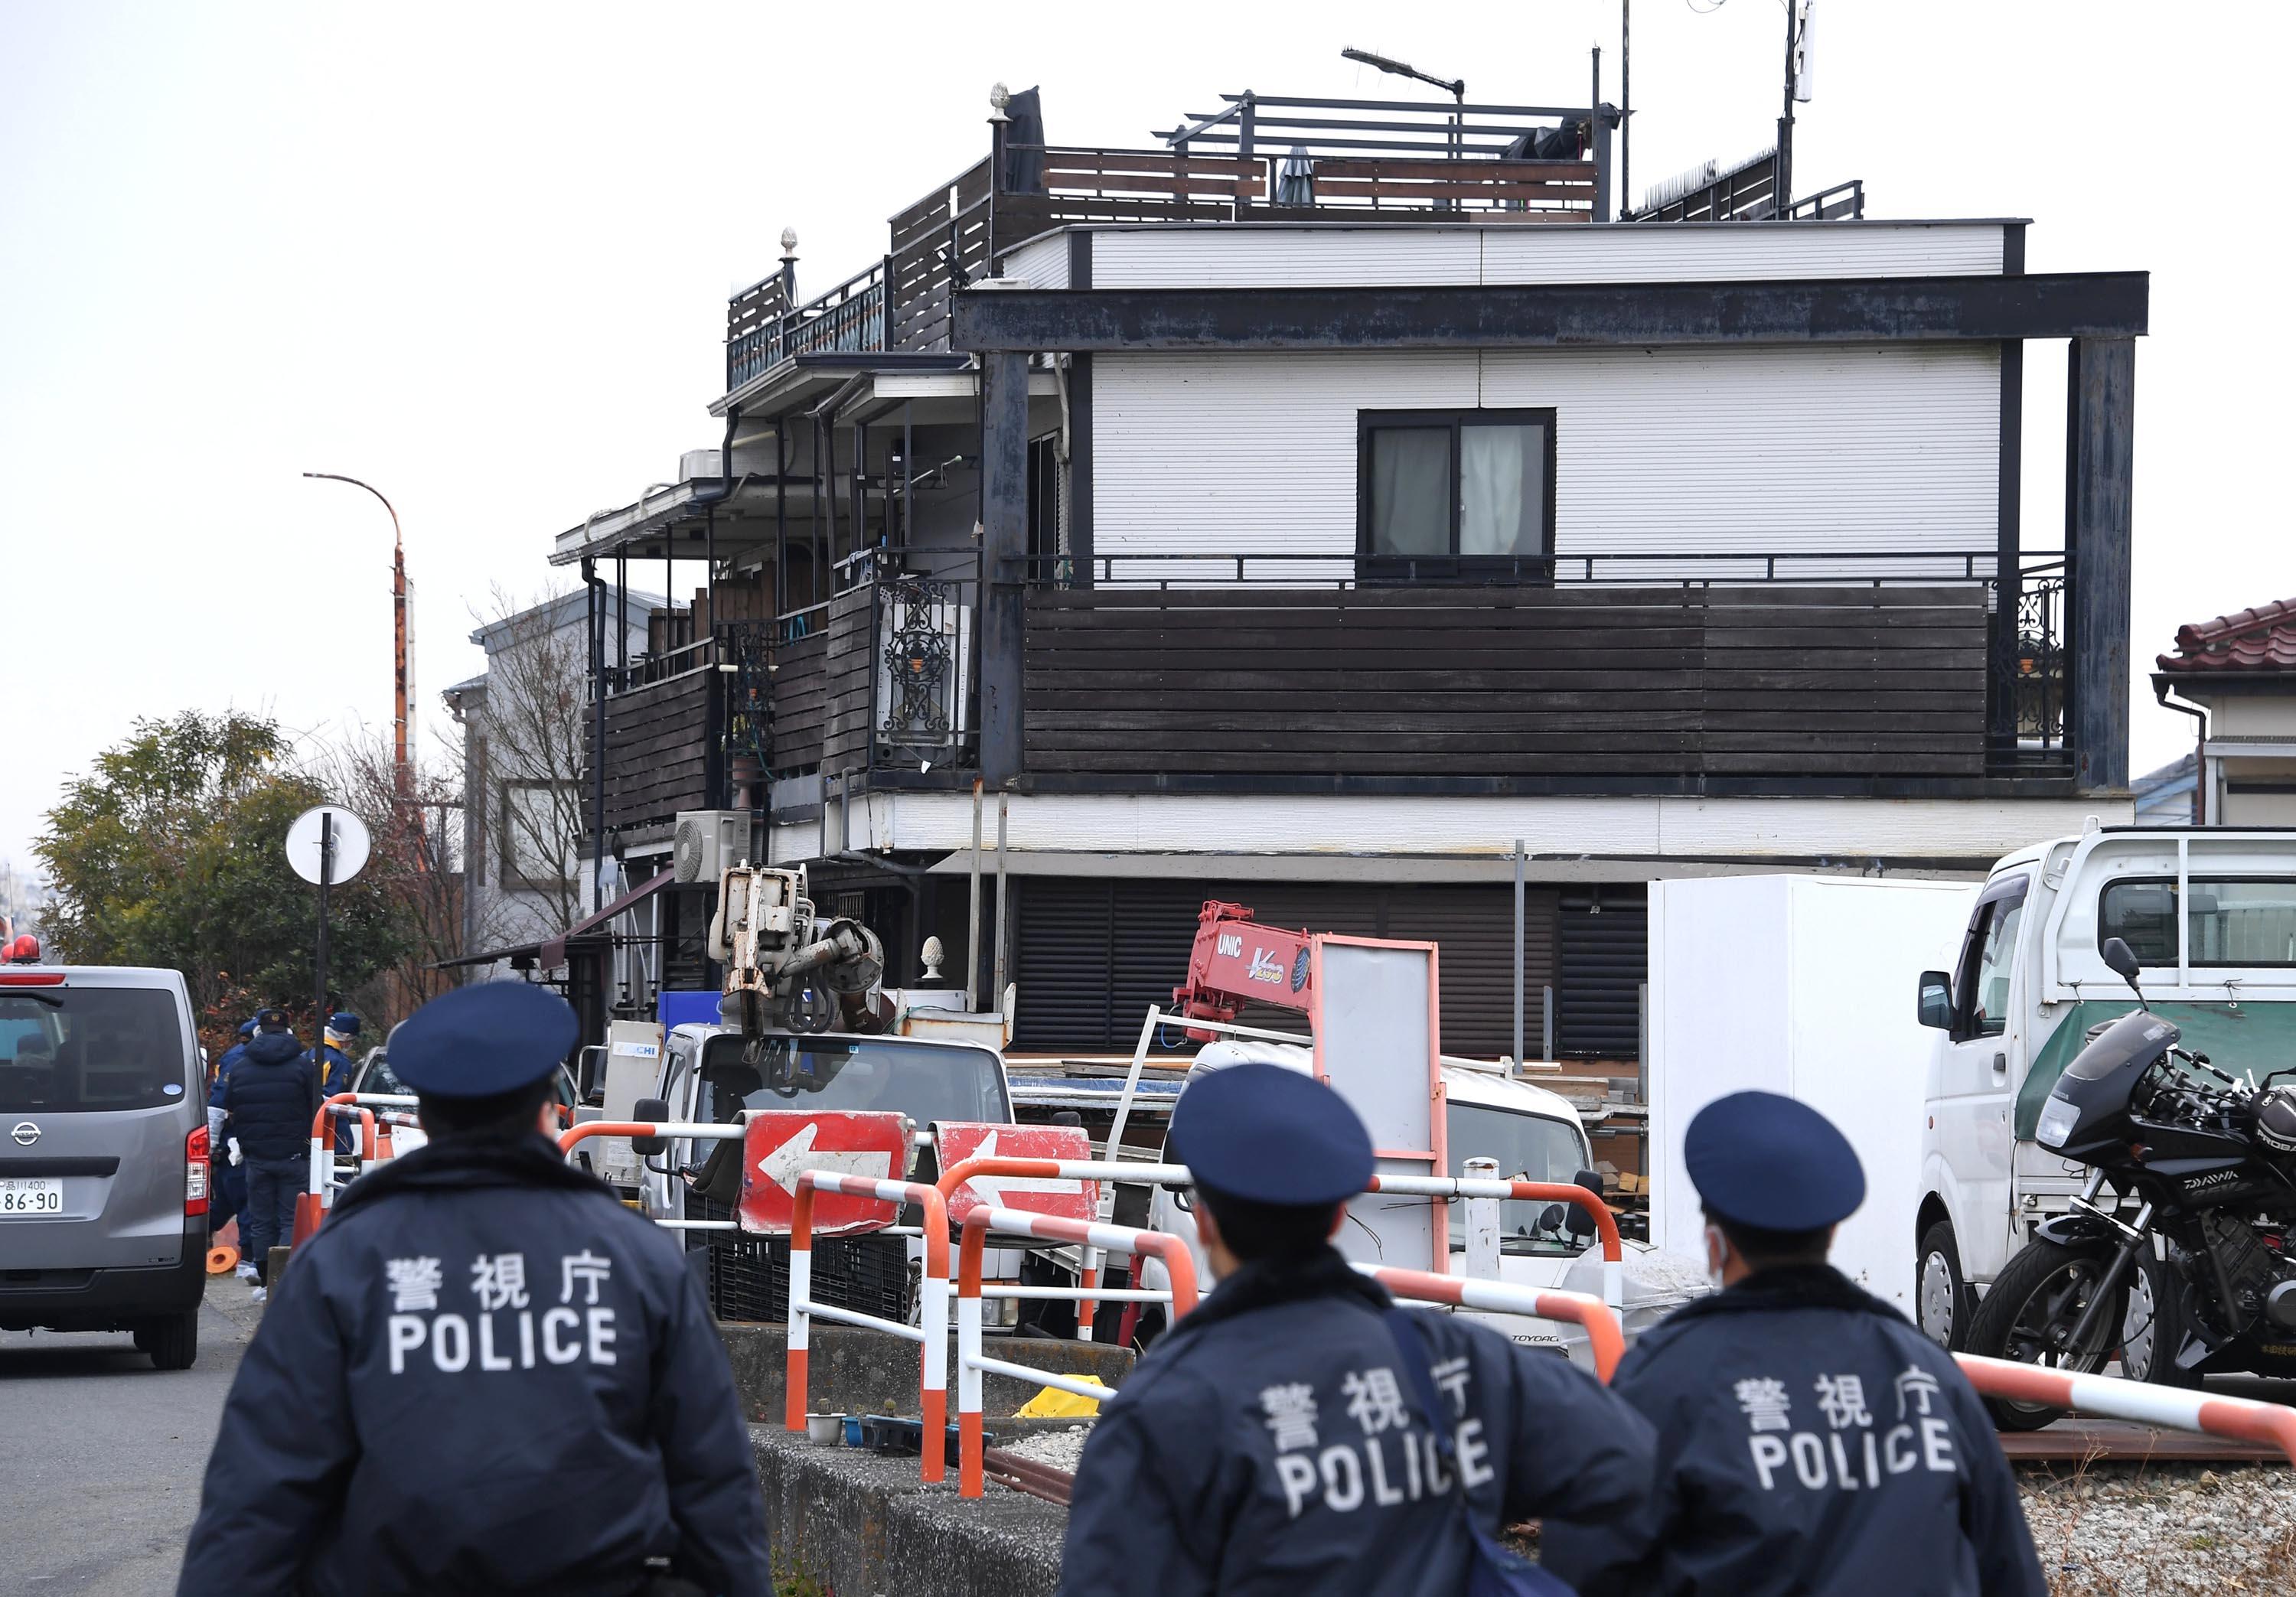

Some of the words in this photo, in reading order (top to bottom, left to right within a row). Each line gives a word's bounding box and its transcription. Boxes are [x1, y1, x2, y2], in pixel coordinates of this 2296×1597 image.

[1218, 934, 1241, 957] UNIC
[5, 1193, 58, 1210] 86-90
[6, 1181, 46, 1191] 品川400
[2183, 1171, 2239, 1189] DAIWA
[386, 1249, 612, 1312] 警視庁
[388, 1307, 617, 1374] POLICE
[1733, 1364, 1940, 1432] 警視庁
[1274, 1418, 1494, 1518] POLICE
[1748, 1417, 1957, 1491] POLICE
